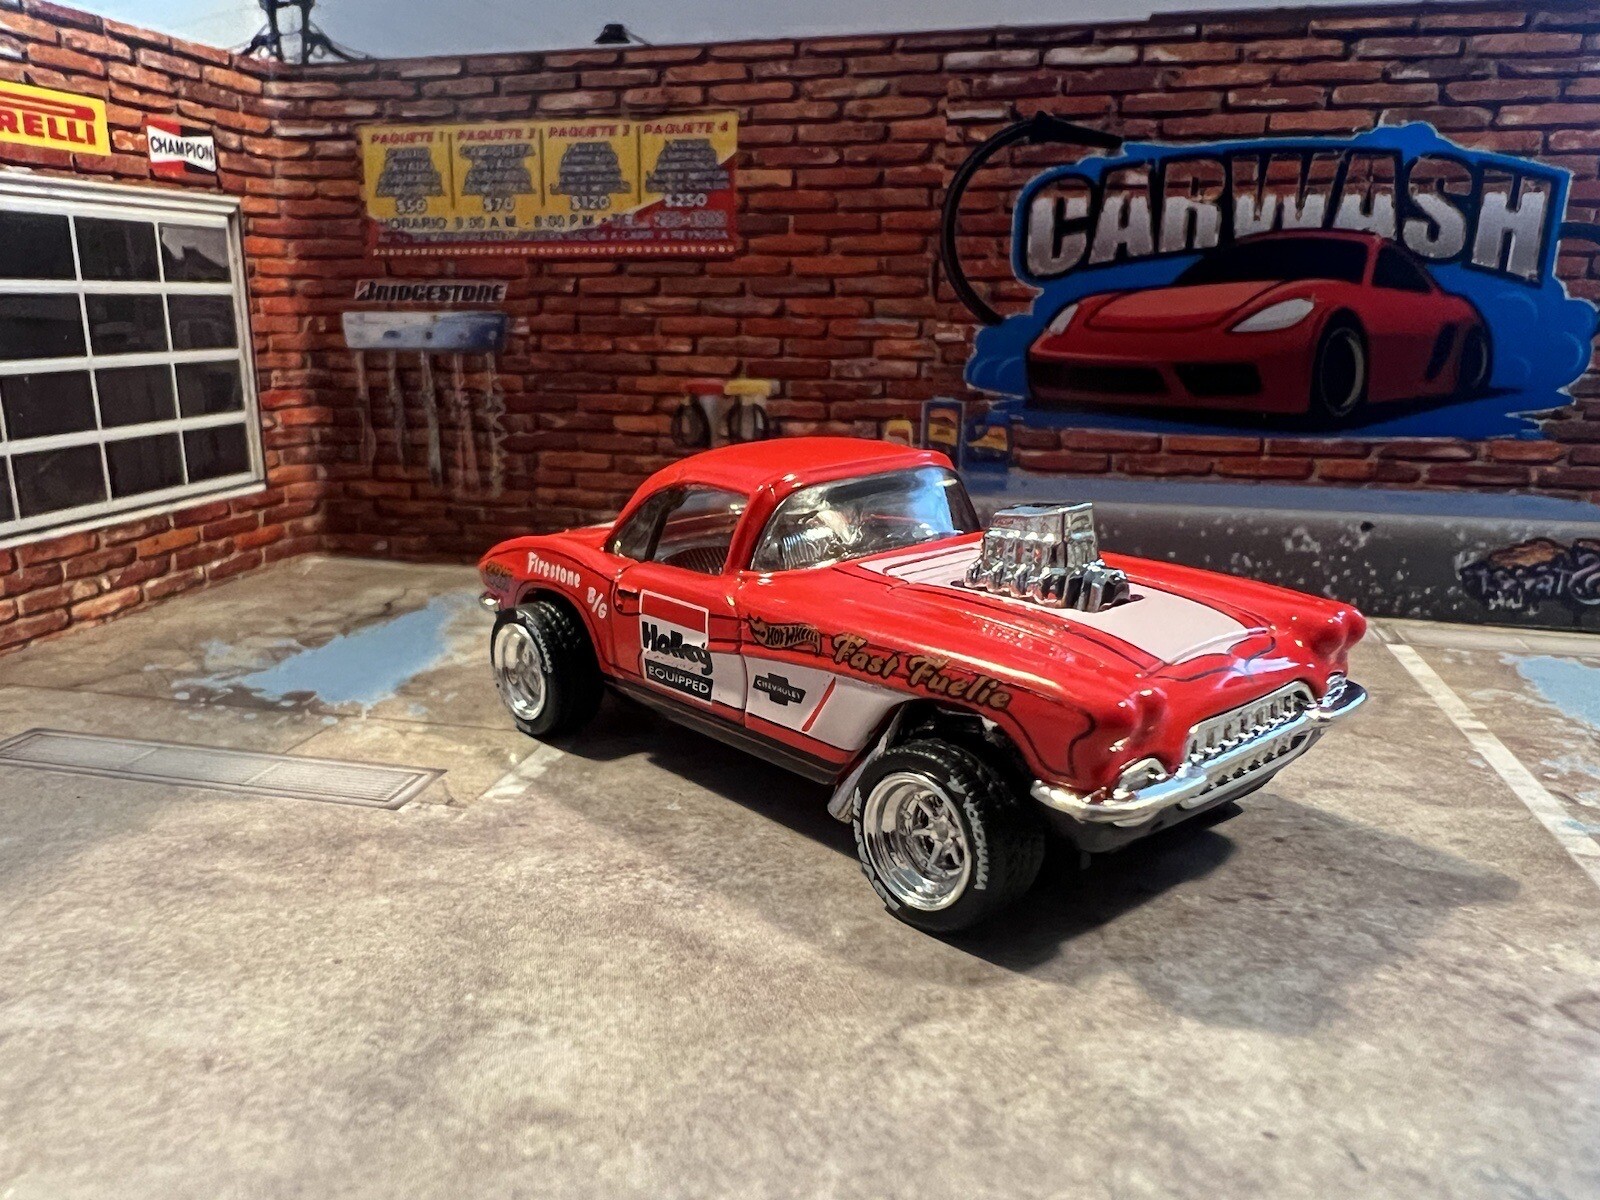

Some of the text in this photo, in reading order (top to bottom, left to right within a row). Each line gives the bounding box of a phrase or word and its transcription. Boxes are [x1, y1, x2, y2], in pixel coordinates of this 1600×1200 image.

[150, 136, 213, 161] CHAMPION
[1026, 153, 1552, 282] CARWASH
[355, 280, 505, 301] BRIDGESTONE
[527, 552, 581, 589] Firestone
[767, 627, 785, 645] HOT
[648, 666, 710, 695] EQUIPPED
[831, 632, 1012, 710] Fast Fuelie
